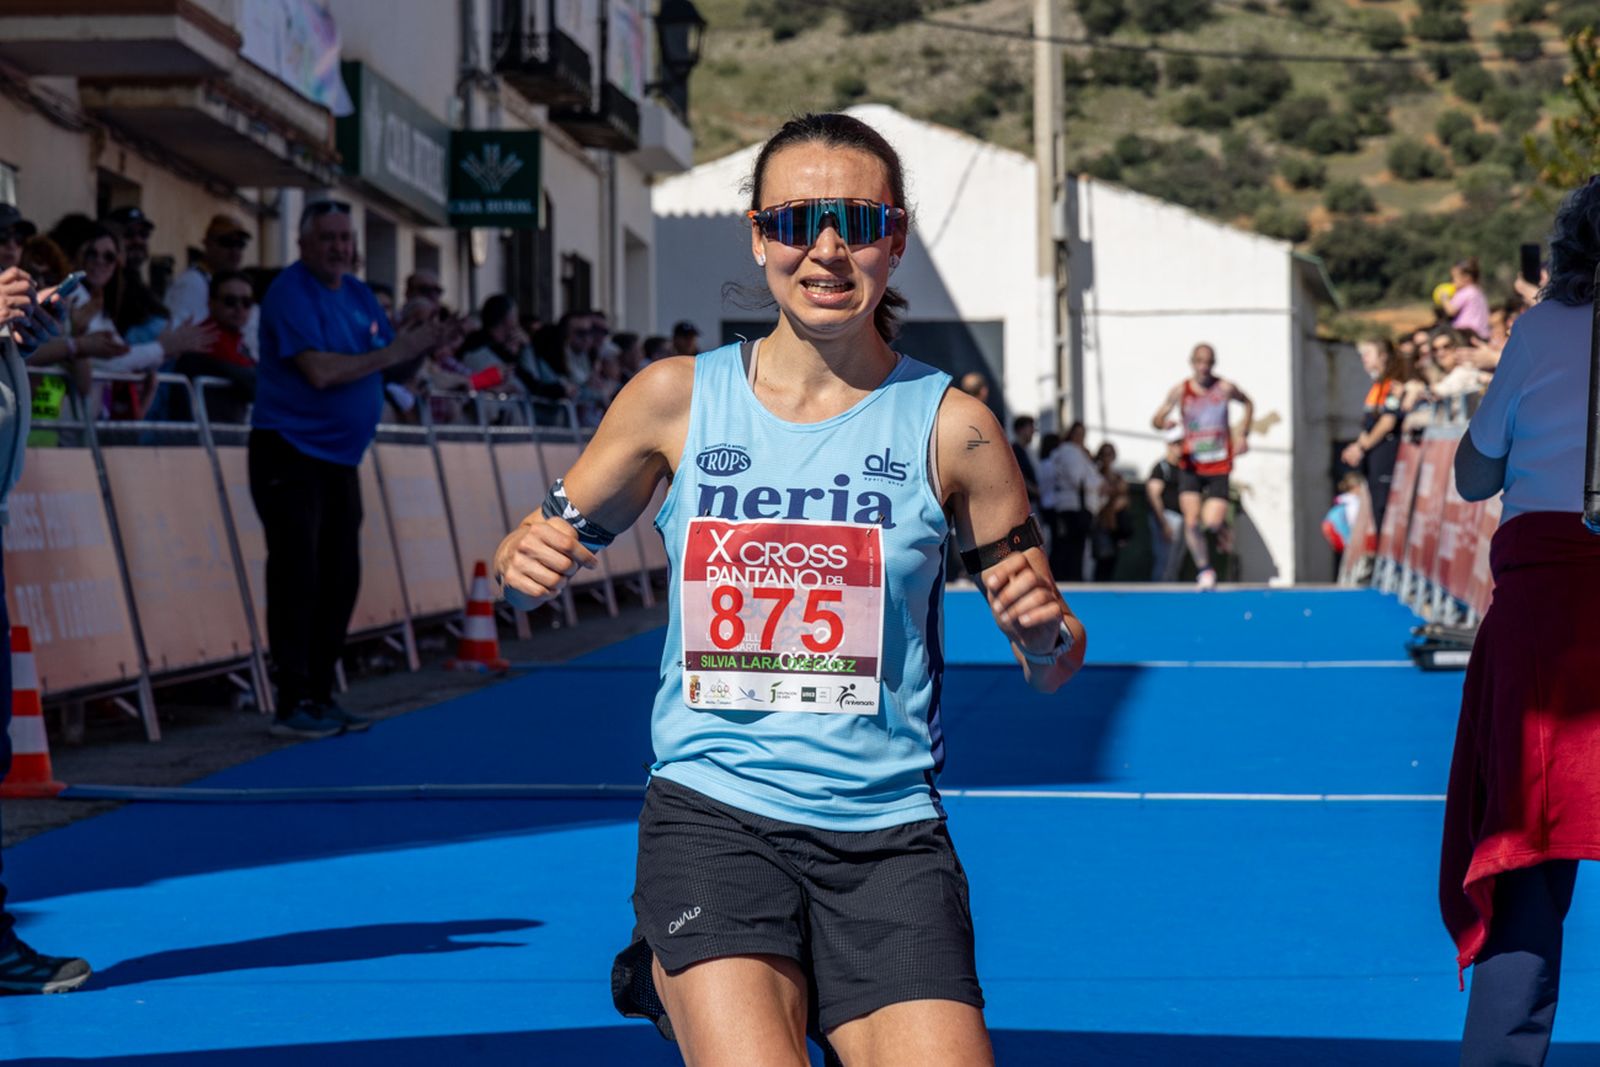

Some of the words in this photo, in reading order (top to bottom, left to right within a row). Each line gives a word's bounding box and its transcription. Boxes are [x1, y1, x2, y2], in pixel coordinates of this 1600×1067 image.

[699, 450, 749, 470] TROPS
[862, 447, 907, 481] als
[696, 474, 896, 529] neria
[706, 529, 735, 563] X
[739, 541, 847, 569] CROSS
[706, 566, 822, 590] PANTANO
[826, 575, 847, 586] DEL
[710, 585, 844, 653] 875
[700, 655, 737, 669] SILVIA
[741, 656, 782, 670] LARA
